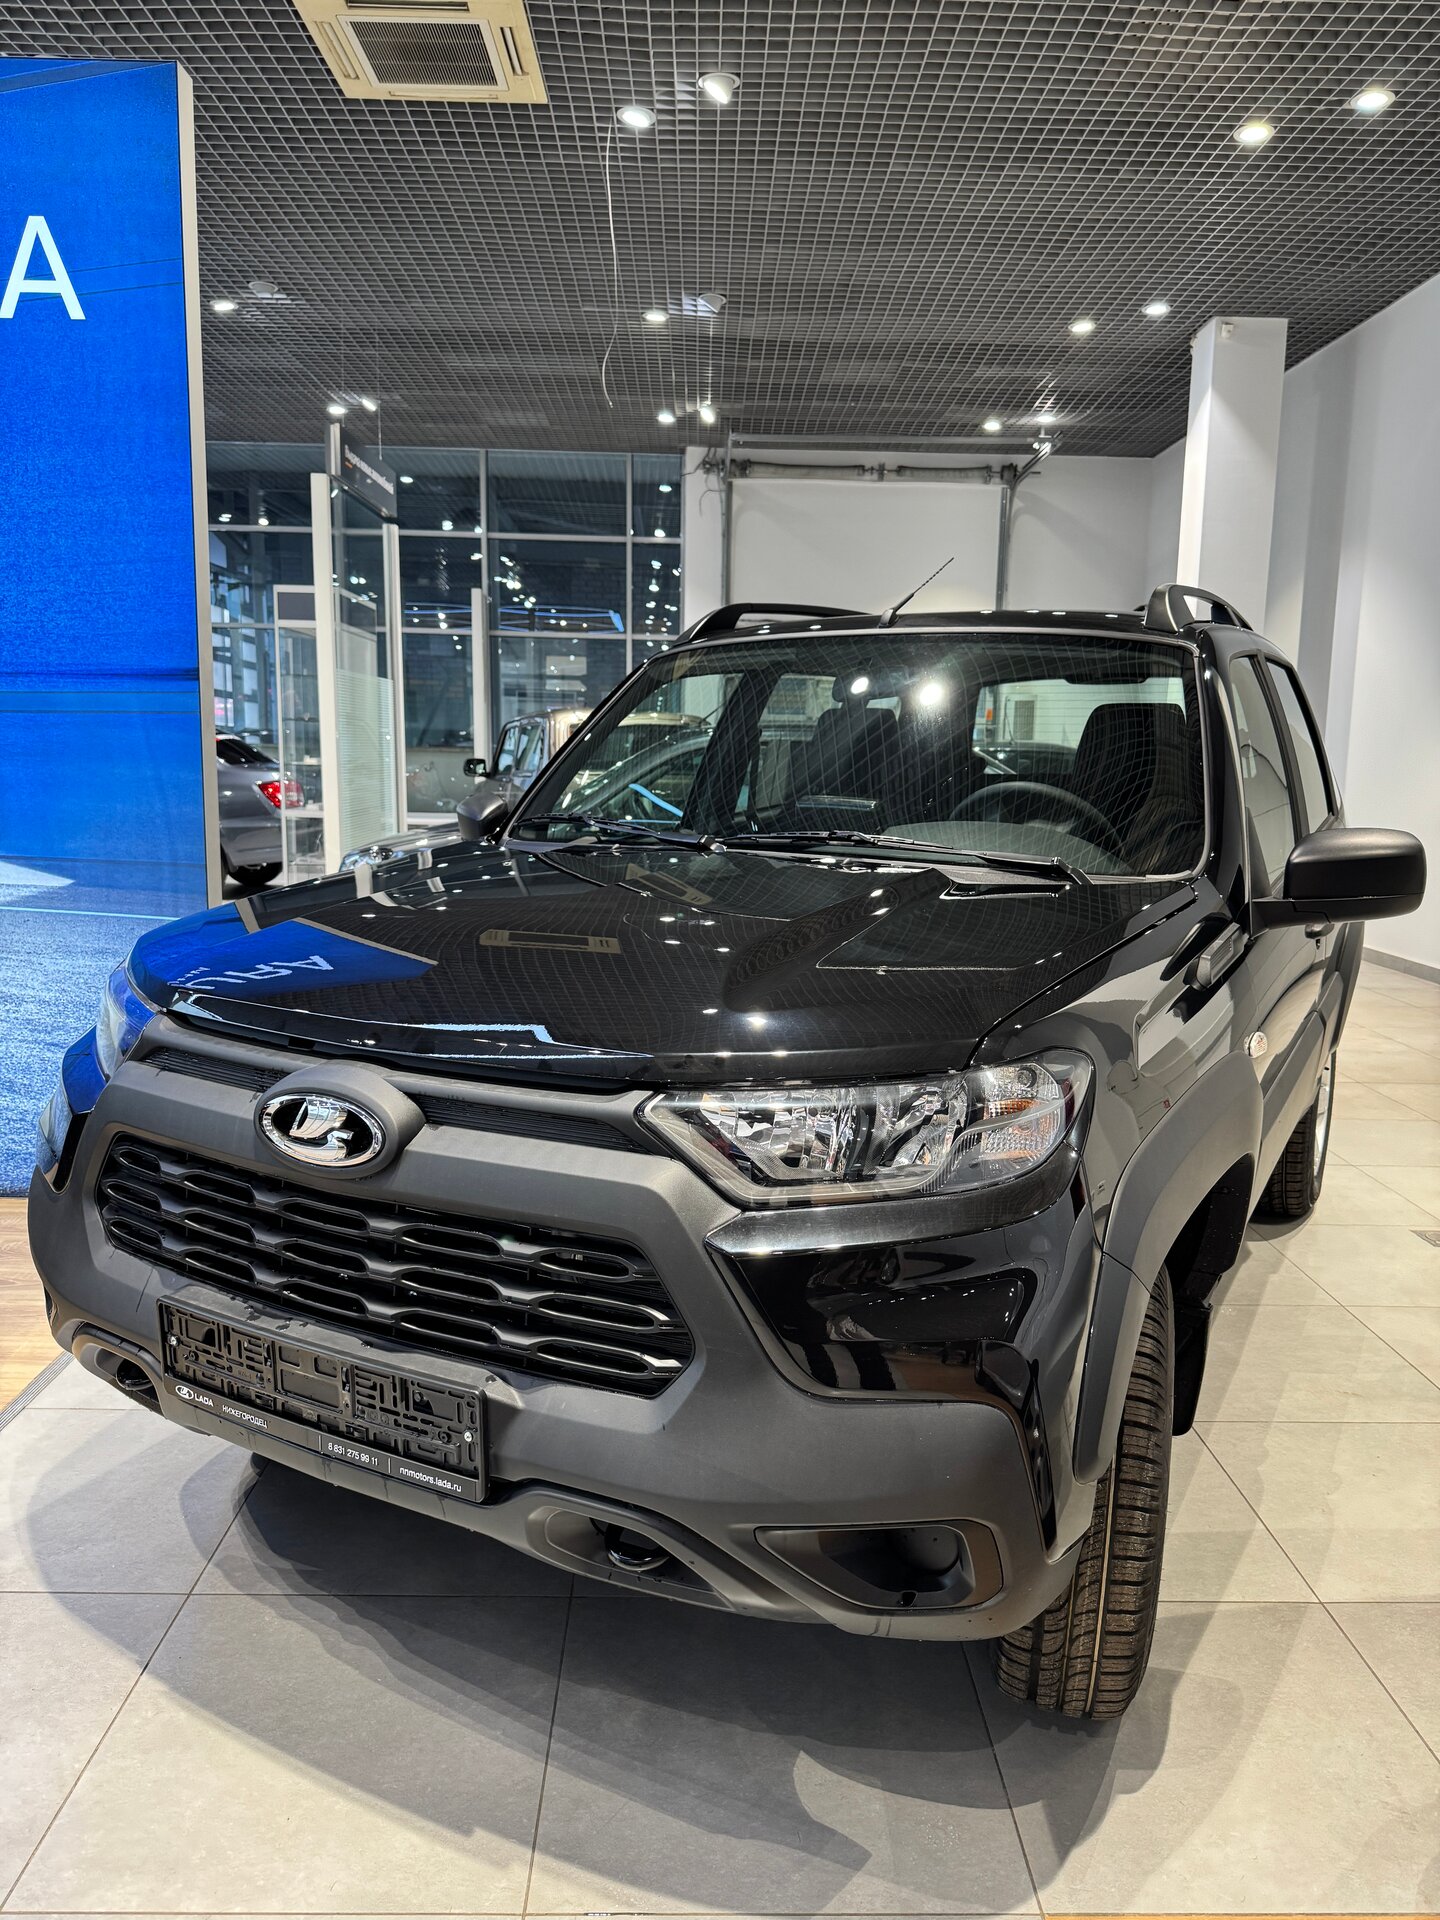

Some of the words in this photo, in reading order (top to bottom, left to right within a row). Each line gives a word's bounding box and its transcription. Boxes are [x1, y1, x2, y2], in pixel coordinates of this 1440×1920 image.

[194, 1392, 214, 1408] LADA
[222, 1405, 268, 1429] НИЖЕГОРОДЕЦ
[327, 1442, 333, 1451] 8
[333, 1444, 346, 1455] 831
[347, 1449, 360, 1460] 275
[361, 1453, 370, 1463] 99
[371, 1457, 378, 1466] 11
[399, 1467, 462, 1493] nnmotors.lada.ru
